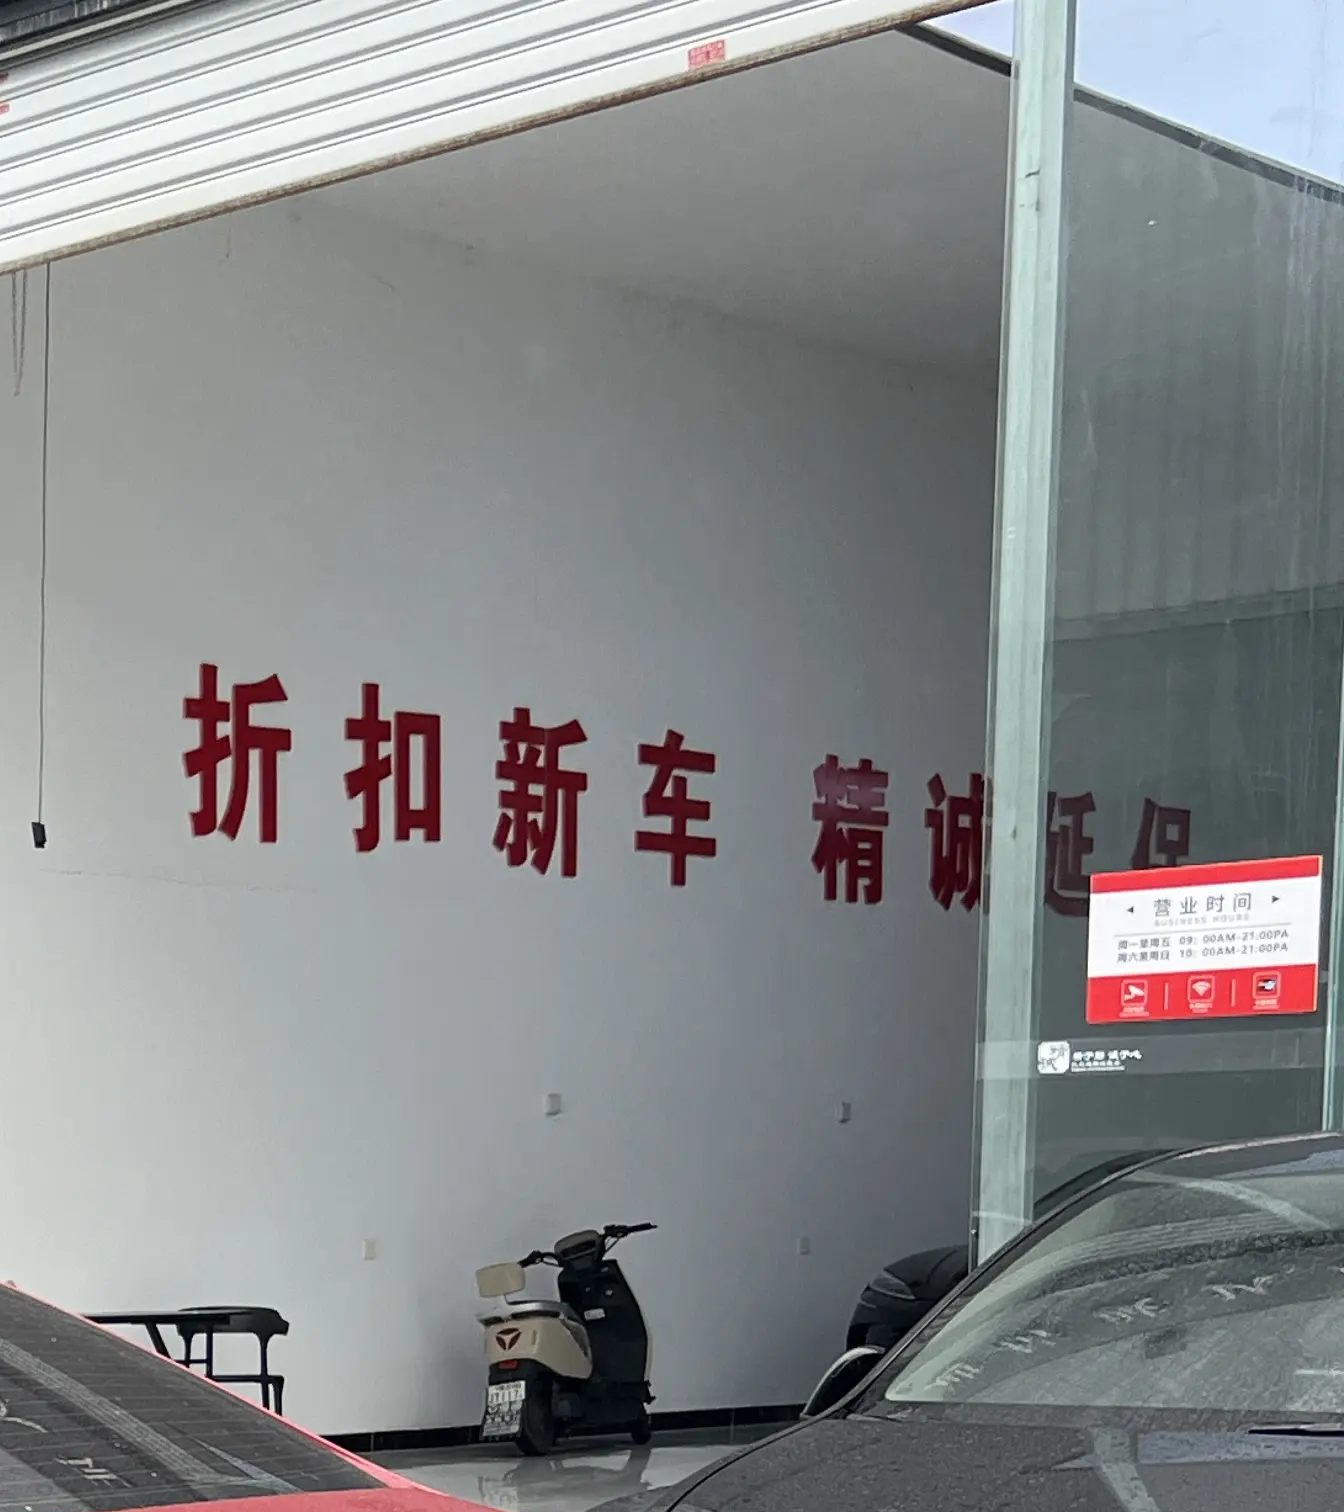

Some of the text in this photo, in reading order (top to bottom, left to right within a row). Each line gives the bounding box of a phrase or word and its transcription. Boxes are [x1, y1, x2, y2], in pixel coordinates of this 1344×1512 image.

[182, 662, 717, 887] 折扣新车
[1153, 892, 1252, 918] 营业时间
